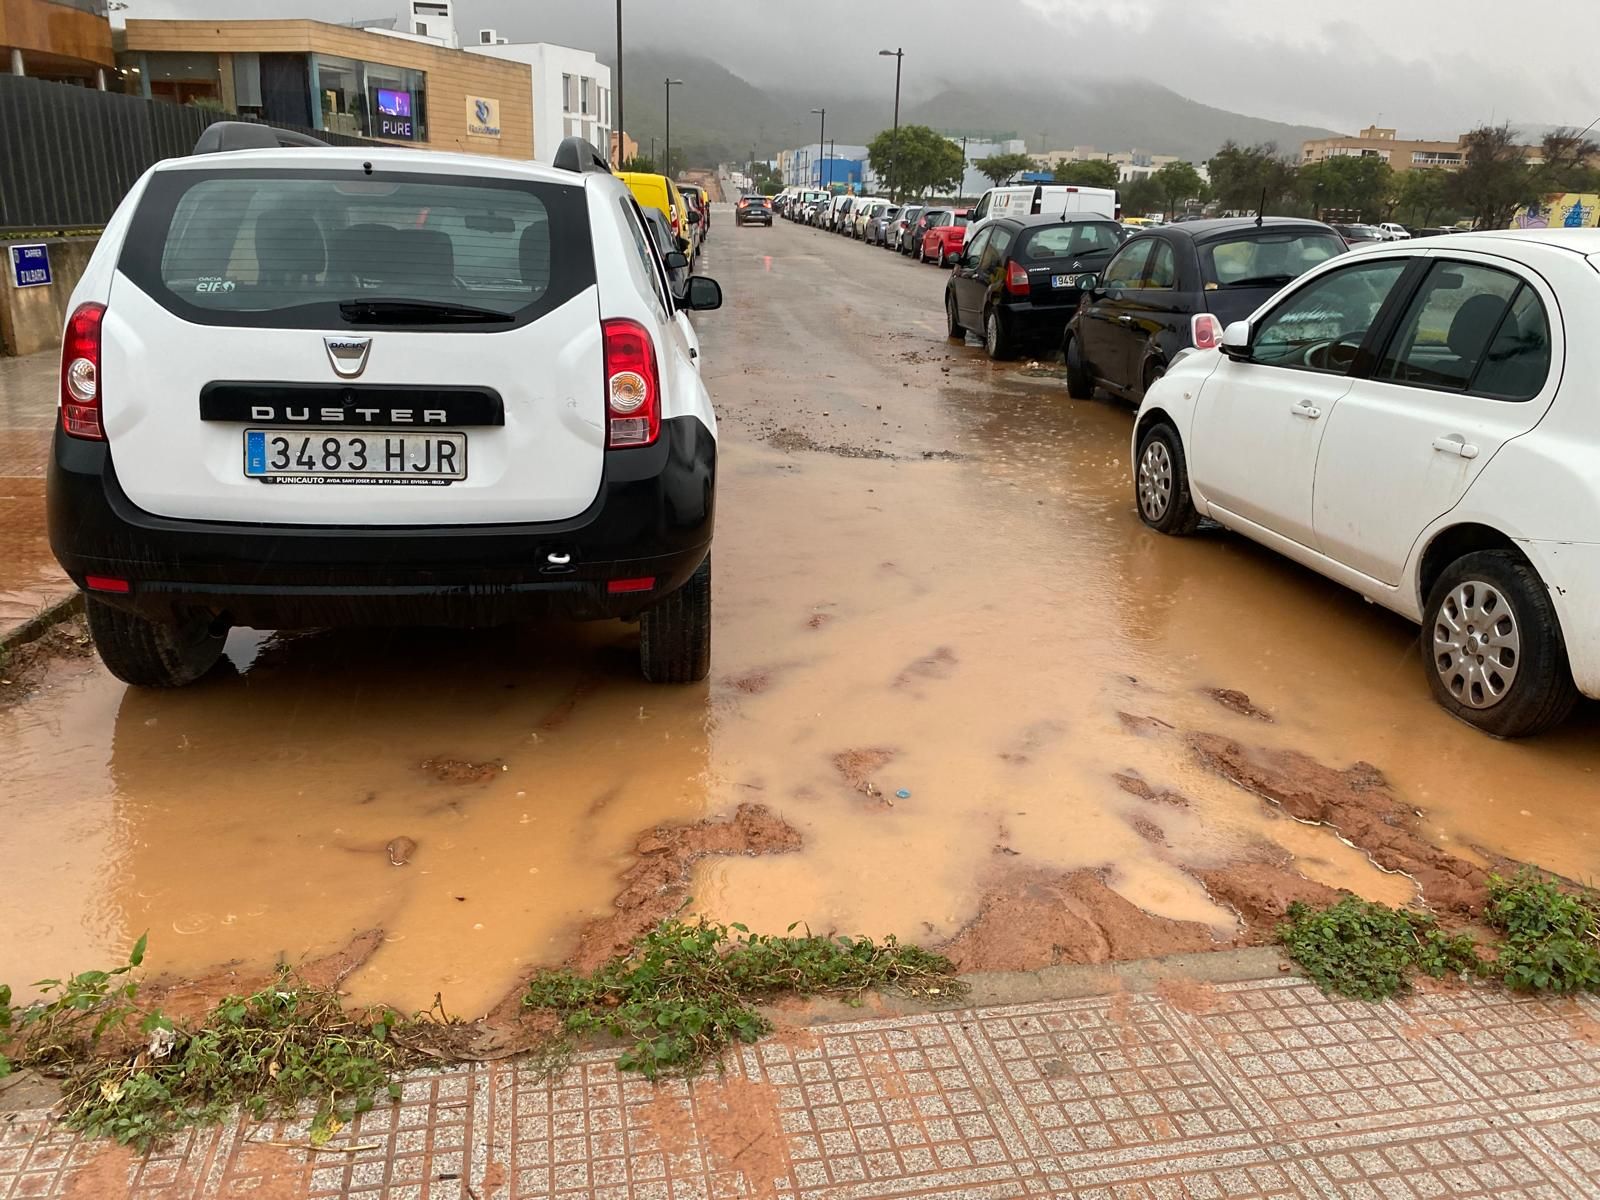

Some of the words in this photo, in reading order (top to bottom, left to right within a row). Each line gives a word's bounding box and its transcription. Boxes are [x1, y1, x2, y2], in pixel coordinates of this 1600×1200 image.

[382, 120, 411, 136] PURE
[196, 281, 222, 292] elf
[251, 406, 447, 423] DUSTER
[270, 437, 368, 471] 3483
[385, 438, 457, 473] HJR
[253, 458, 261, 467] E
[276, 476, 325, 484] PUNICAUTO
